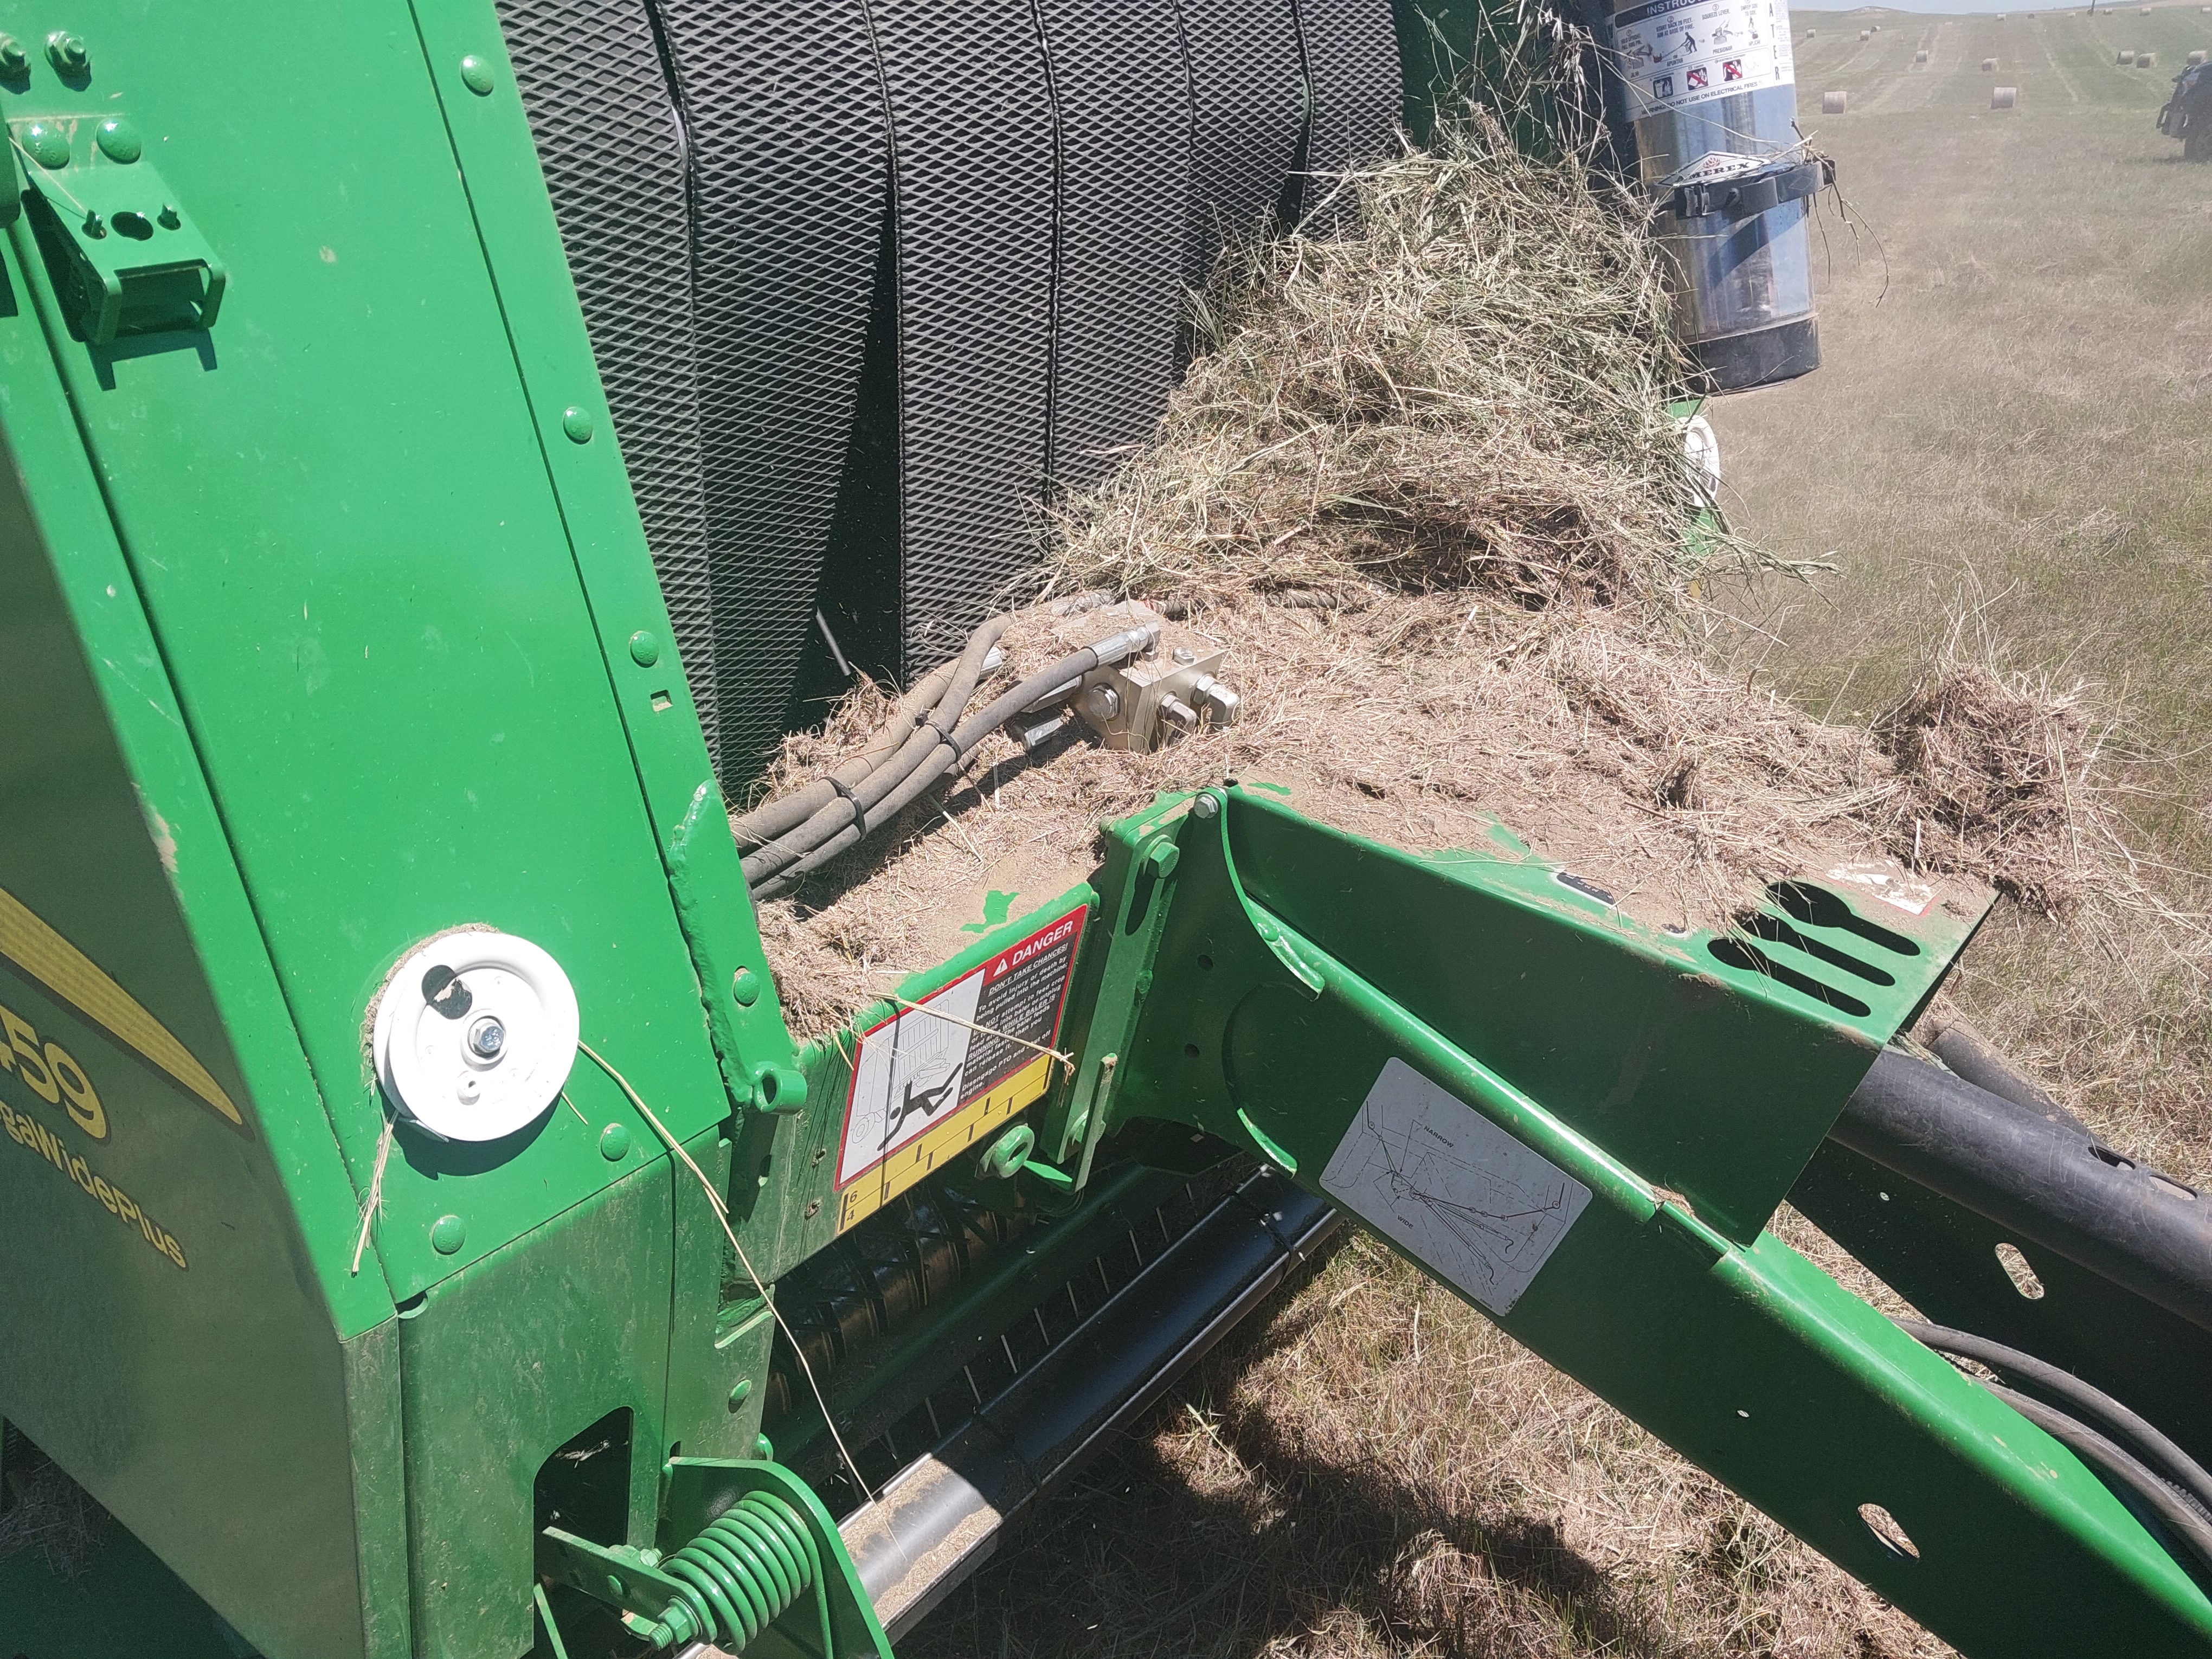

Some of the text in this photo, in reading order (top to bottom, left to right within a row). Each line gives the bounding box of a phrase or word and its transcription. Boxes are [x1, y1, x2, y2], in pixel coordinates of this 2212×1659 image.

[1647, 0, 1701, 15] INSTRUC
[1675, 98, 1687, 106] NOT
[1711, 85, 1743, 98] ELECTRICAL
[1675, 162, 1750, 183] AMEREX
[1012, 921, 1073, 966] DANGER
[988, 942, 1068, 995] DON'T TAKE CHANCES!
[988, 990, 1007, 1007] avoid
[1008, 979, 1028, 994] injury
[1039, 961, 1057, 975] death
[976, 1007, 994, 1021] being
[995, 993, 1015, 1011] pulled
[1016, 986, 1028, 996] into
[1030, 979, 1039, 988] the
[986, 1014, 1000, 1028] NOT
[1001, 998, 1026, 1018] attempt
[1036, 983, 1050, 996] feed
[1051, 975, 1065, 987] crop
[1000, 1014, 1012, 1026] into
[1014, 1003, 1031, 1017] baler
[1039, 984, 1061, 1001] unplug
[1017, 1015, 1032, 1029] baler
[1034, 1005, 1050, 1018] feeds
[966, 1046, 994, 1068] material
[1015, 1025, 1029, 1037] than
[1031, 1015, 1042, 1029] you
[970, 1038, 985, 1052] feed
[1002, 1013, 1024, 1031] WHILE
[1025, 999, 1047, 1016] BALER
[1049, 993, 1056, 1002] IS
[962, 1066, 996, 1091] Disengage
[998, 1056, 1012, 1068] PTO
[1013, 1045, 1025, 1059] and
[1041, 1029, 1051, 1039] off
[964, 1065, 977, 1077] can
[979, 1049, 1004, 1068] release
[1424, 1126, 1454, 1148] NARROW
[0, 1100, 185, 1268] gaWidePlus
[850, 1190, 858, 1203] 6
[846, 1208, 854, 1221] 4
[1397, 1214, 1414, 1229] WIDE
